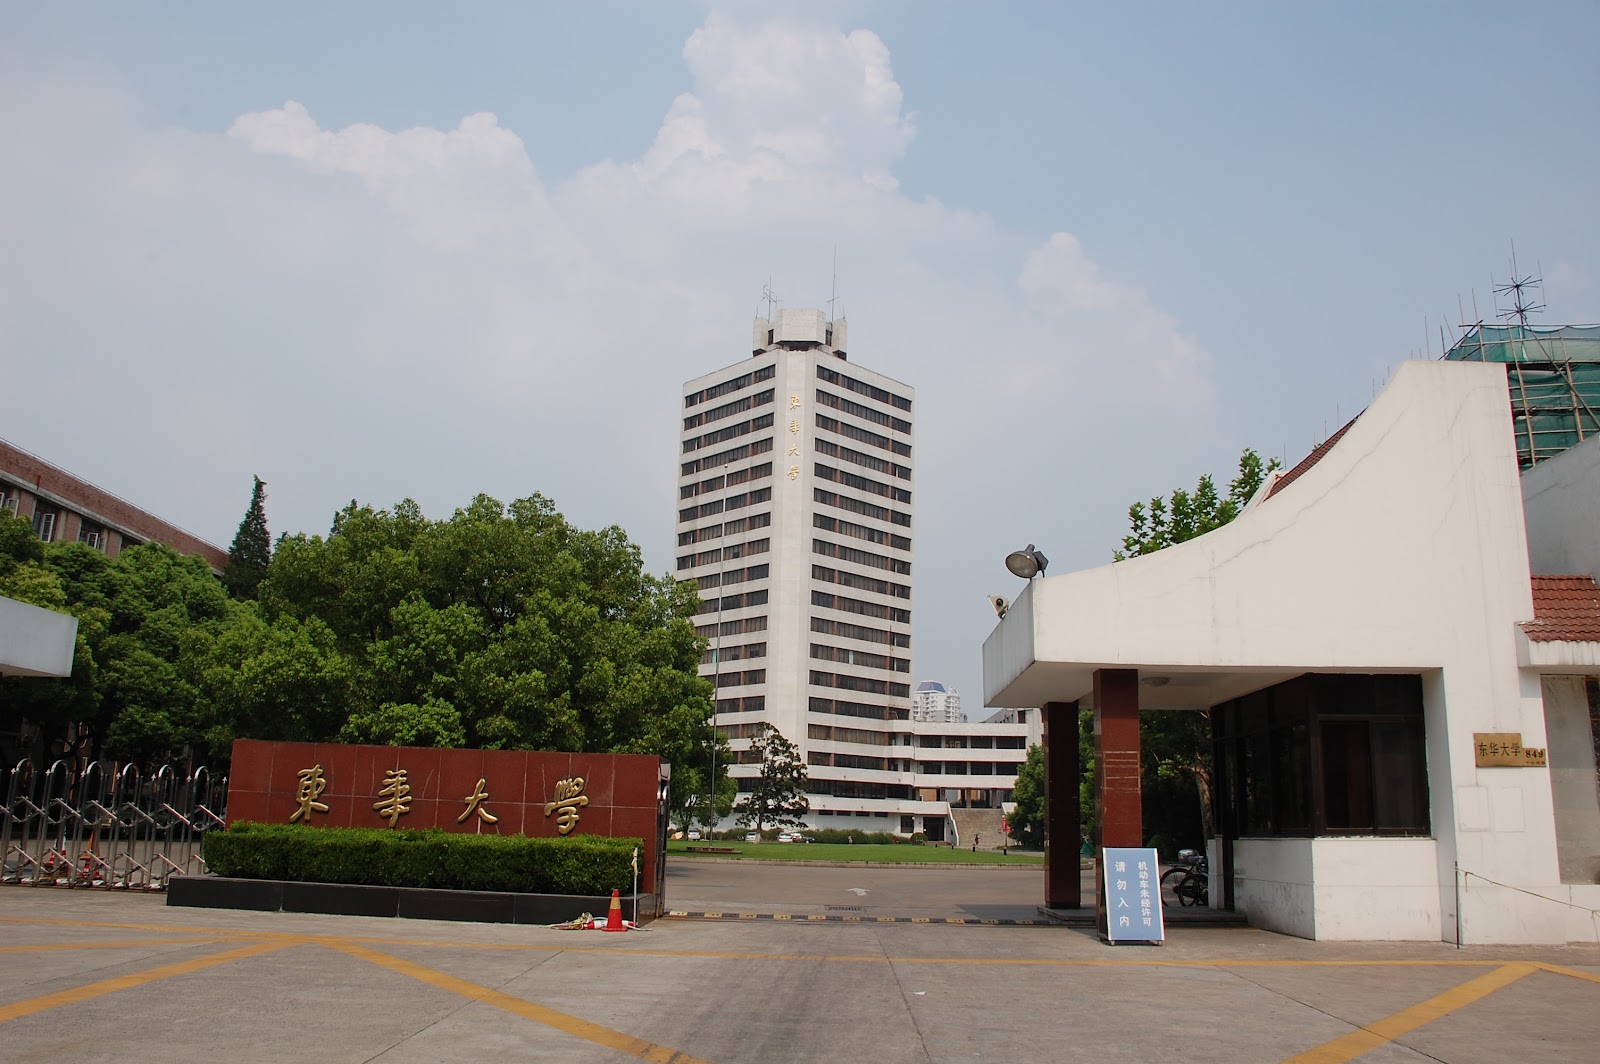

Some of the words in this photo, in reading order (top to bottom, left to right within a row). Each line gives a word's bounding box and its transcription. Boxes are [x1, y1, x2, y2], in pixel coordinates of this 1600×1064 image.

[1478, 742, 1520, 757] 东华大学
[289, 764, 589, 835] 東華大學
[1115, 861, 1129, 927] 请勿入内
[1137, 861, 1152, 927] 机动车未经许可
